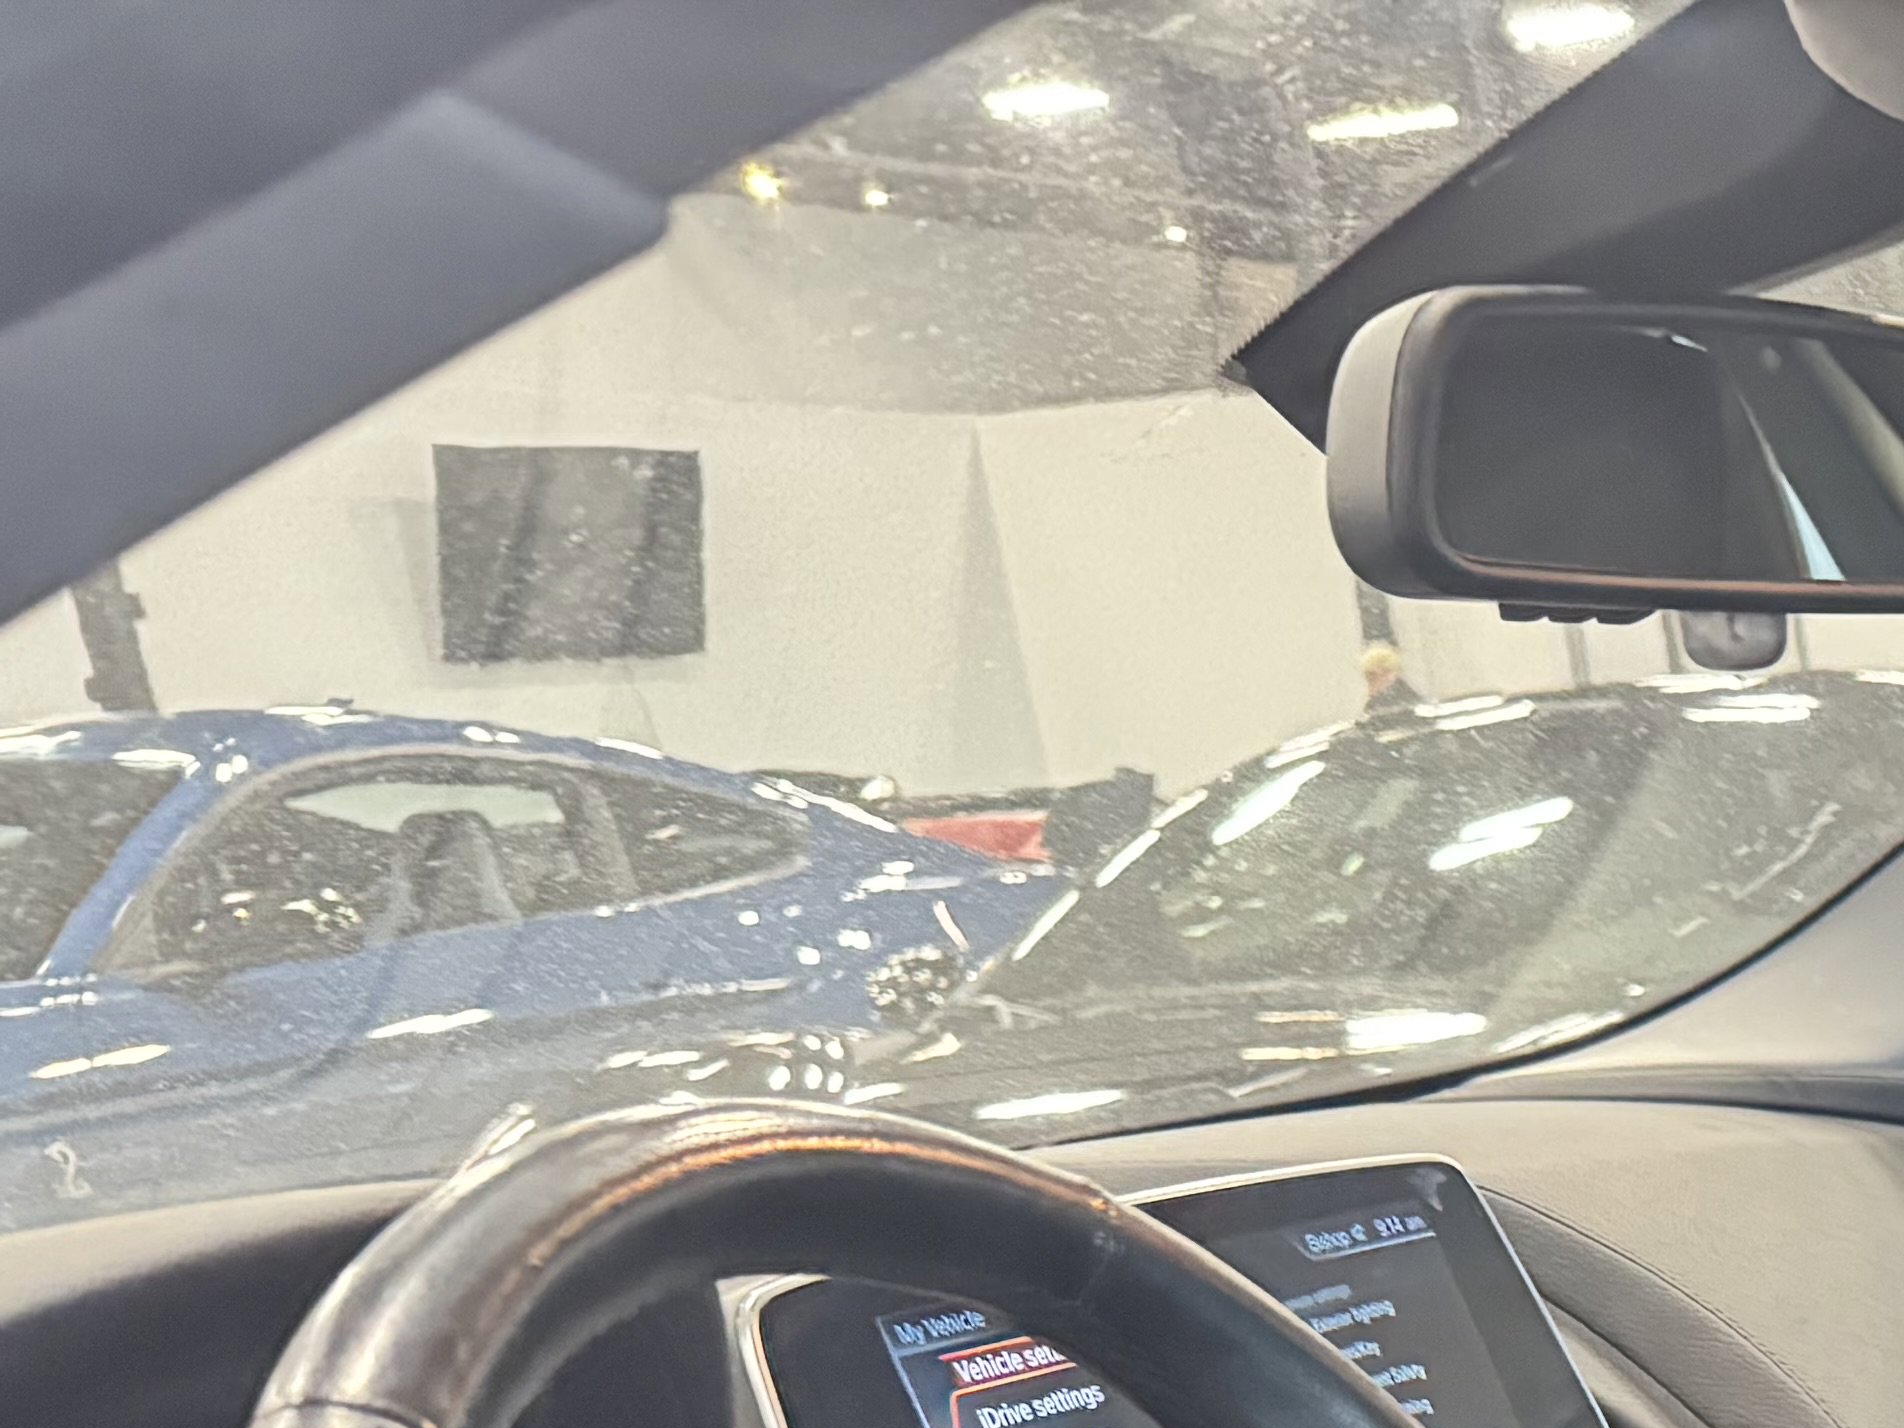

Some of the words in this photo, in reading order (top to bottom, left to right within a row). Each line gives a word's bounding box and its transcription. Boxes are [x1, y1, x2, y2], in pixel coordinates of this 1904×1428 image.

[893, 1323, 927, 1346] My
[924, 1309, 986, 1338] Vehicle
[952, 1350, 1025, 1383] Vehicle
[1032, 1384, 1106, 1418] settings
